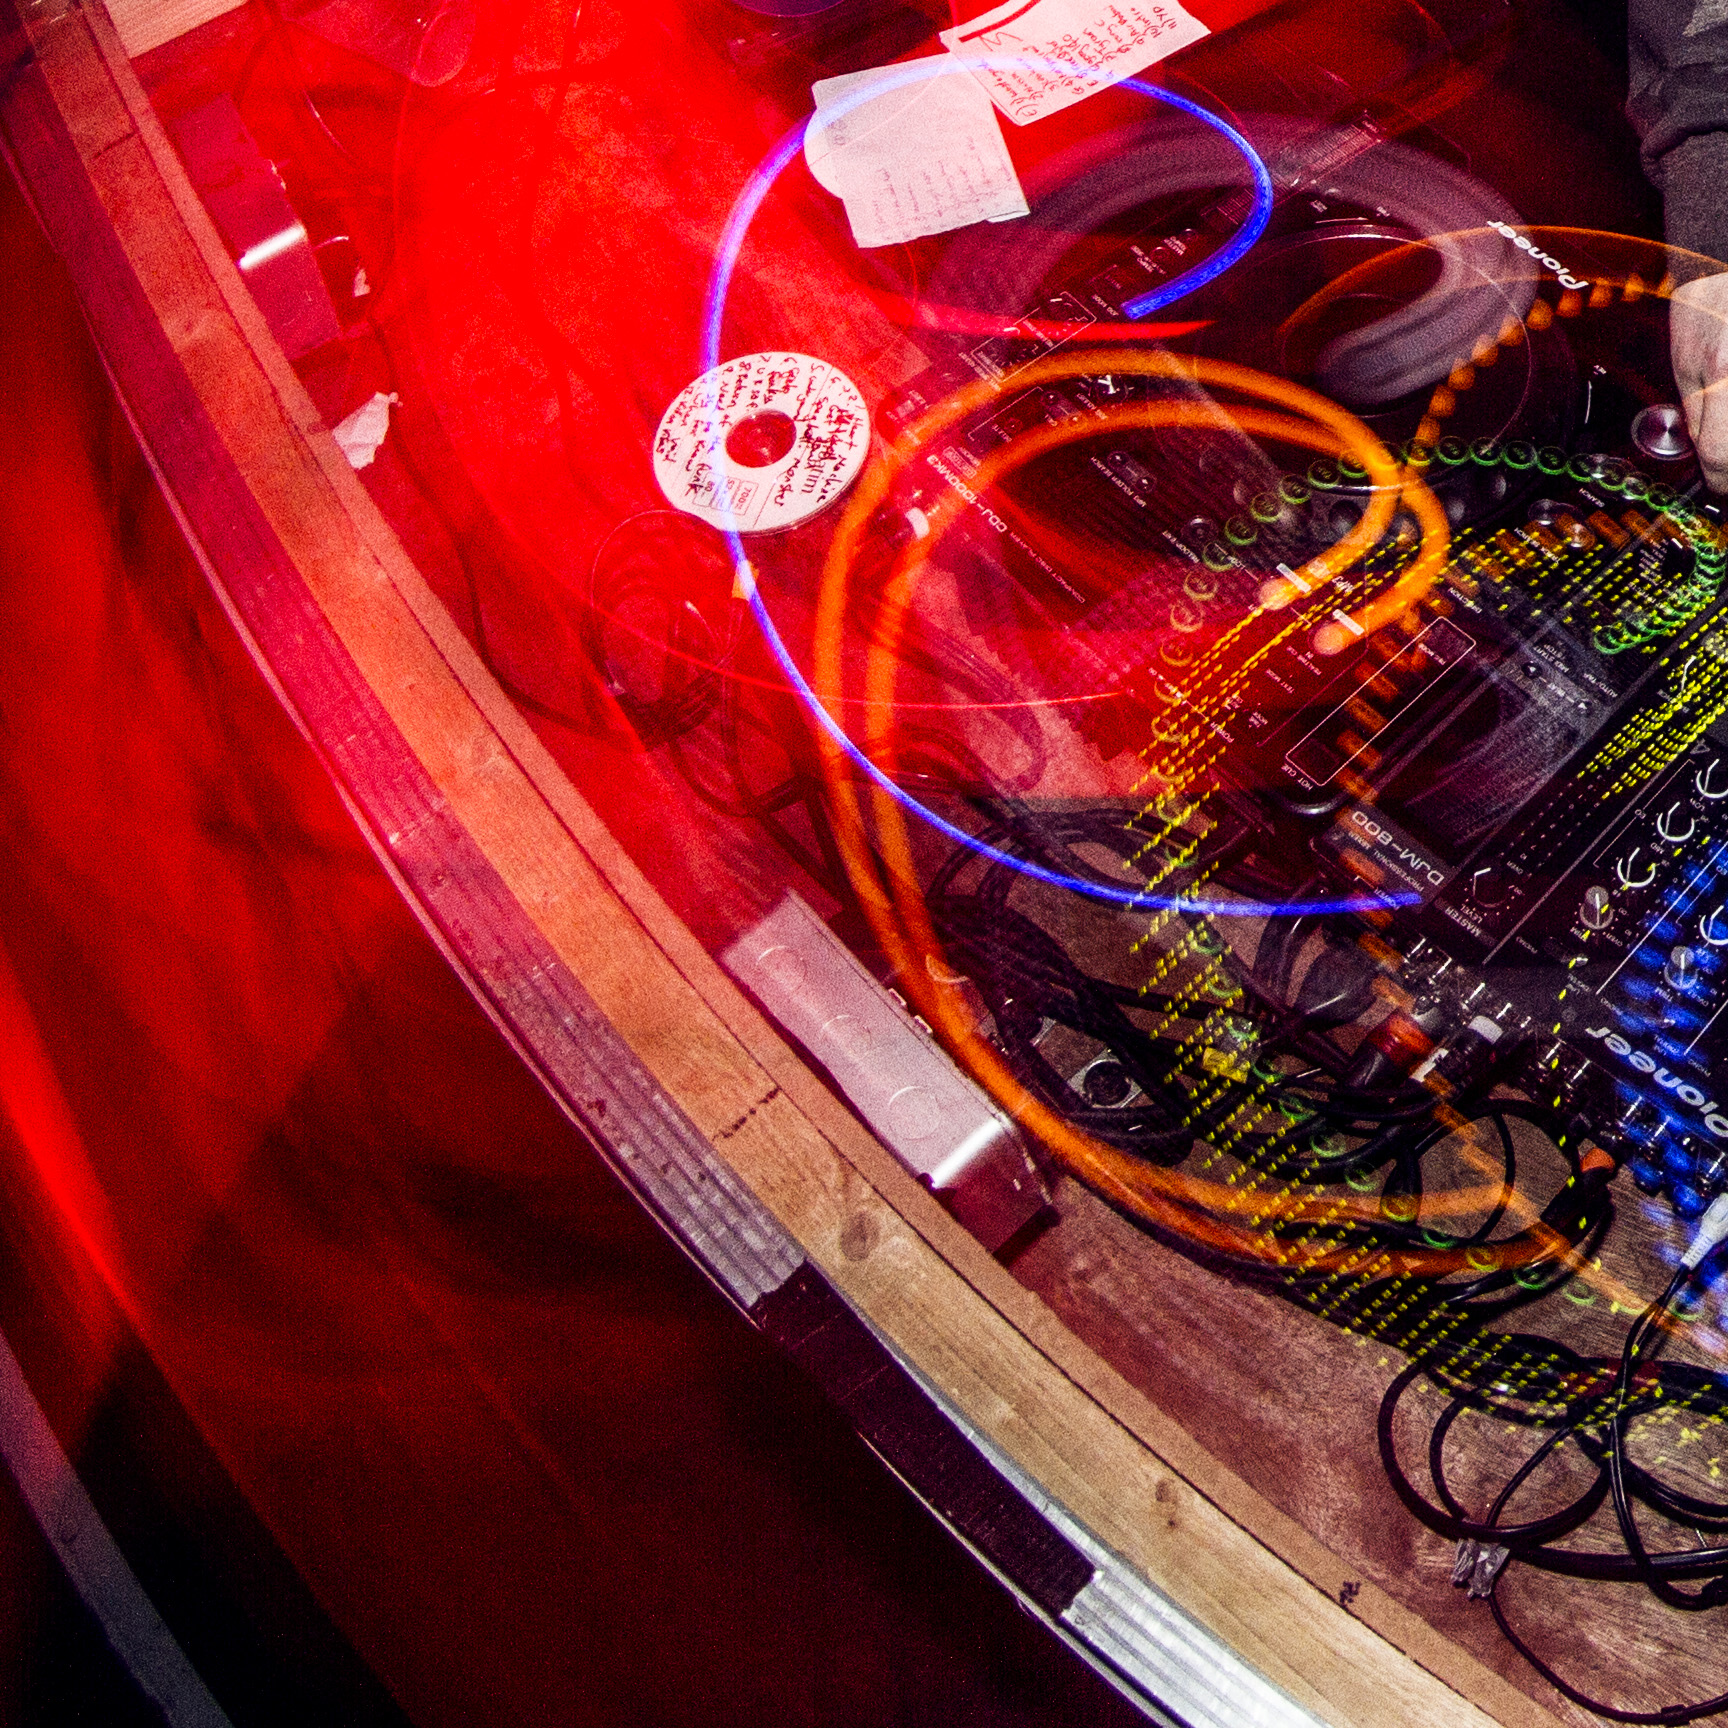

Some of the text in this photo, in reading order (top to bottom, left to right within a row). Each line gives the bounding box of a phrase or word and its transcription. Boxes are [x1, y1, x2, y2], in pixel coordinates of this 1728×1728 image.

[1487, 218, 1589, 291] Pioneer
[922, 451, 1011, 535] CDJ-1000MK3
[1577, 485, 1605, 510] SEARCH
[1512, 525, 1538, 548] SEARCH
[1531, 642, 1558, 665] START
[1208, 719, 1235, 743] POWER
[1687, 735, 1714, 762] 4
[1280, 761, 1314, 791] HOT CUE
[1633, 806, 1647, 819] EQ
[1348, 808, 1446, 886] DJM-800
[1648, 840, 1664, 855] MID
[1369, 847, 1426, 892] PROFESSIONAL
[1443, 904, 1482, 937] MASTER
[1458, 901, 1484, 924] LEVEL
[1653, 985, 1674, 1003] TRIM
